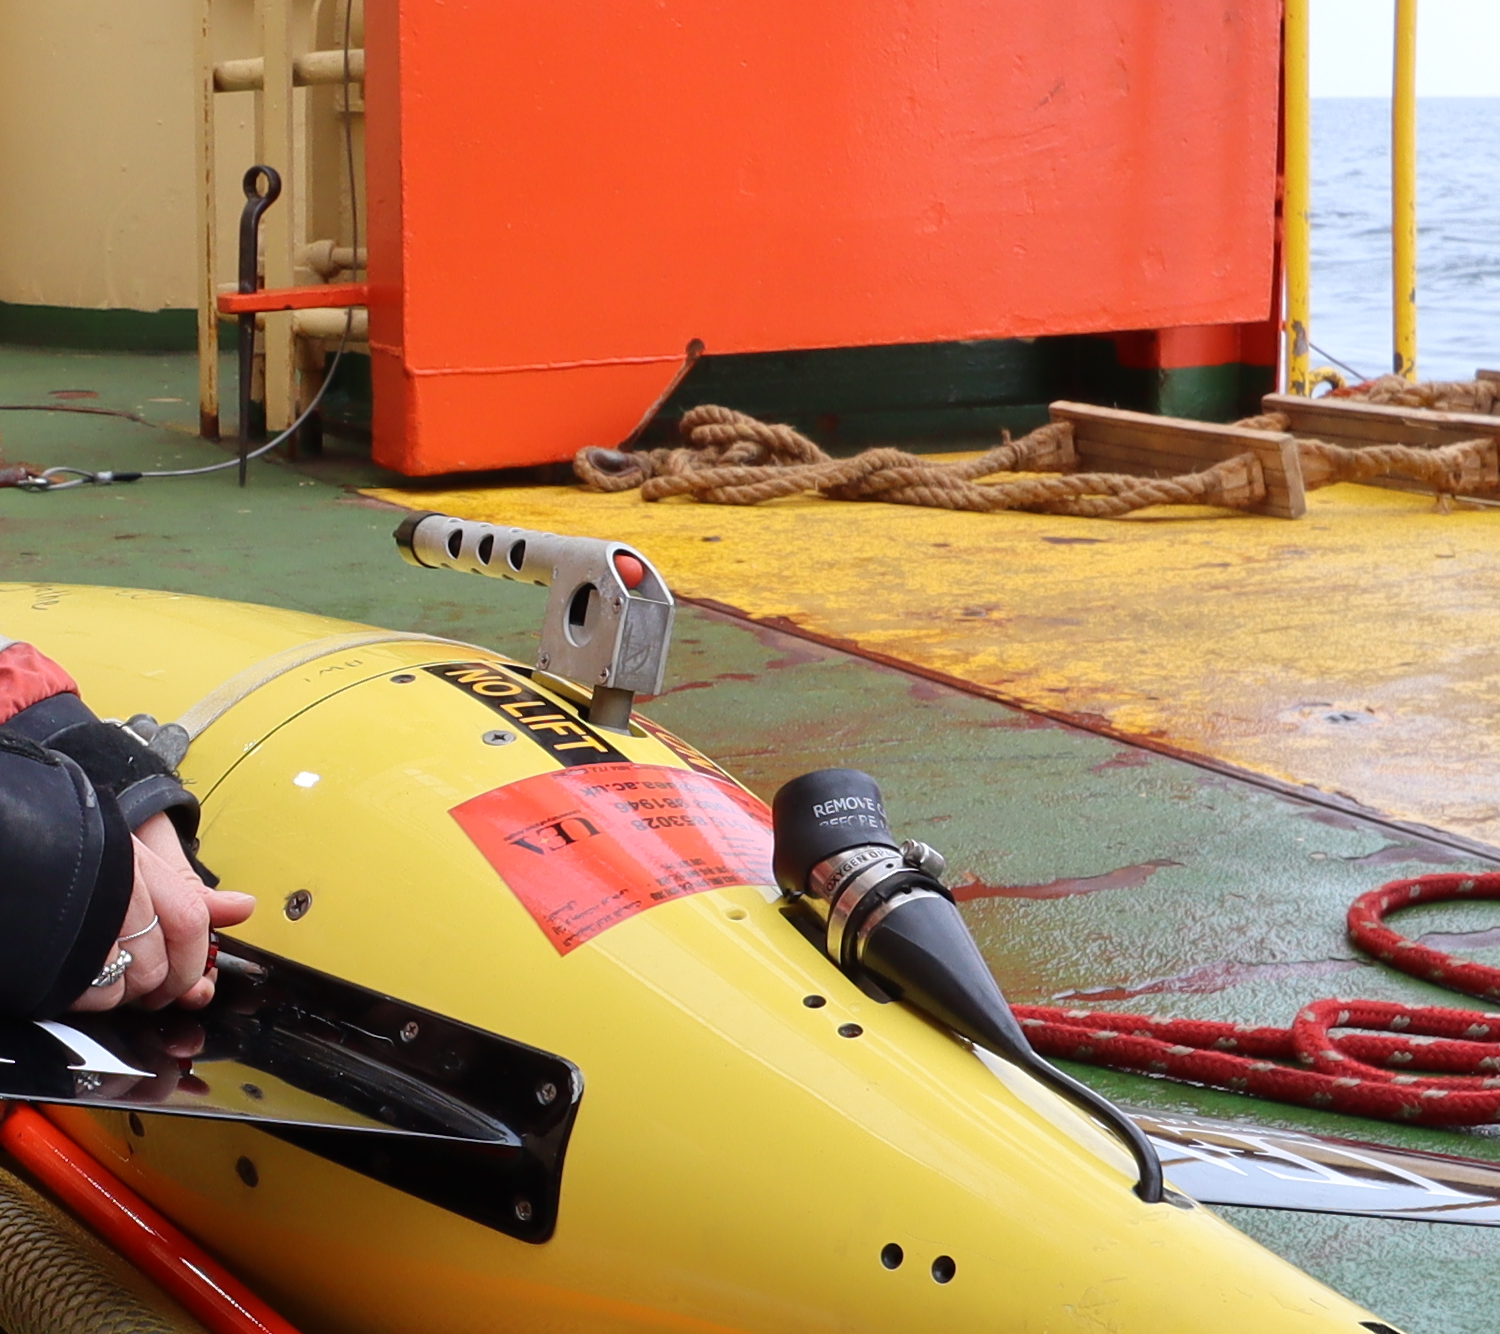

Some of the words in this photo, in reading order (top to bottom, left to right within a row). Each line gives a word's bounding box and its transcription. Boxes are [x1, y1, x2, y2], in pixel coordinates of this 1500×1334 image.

[445, 669, 522, 696] NO
[500, 700, 608, 754] LIFT
[630, 815, 708, 831] 853028
[813, 796, 875, 817] REMOVE
[510, 817, 601, 855] UEA
[825, 856, 868, 892] OXYGEN
